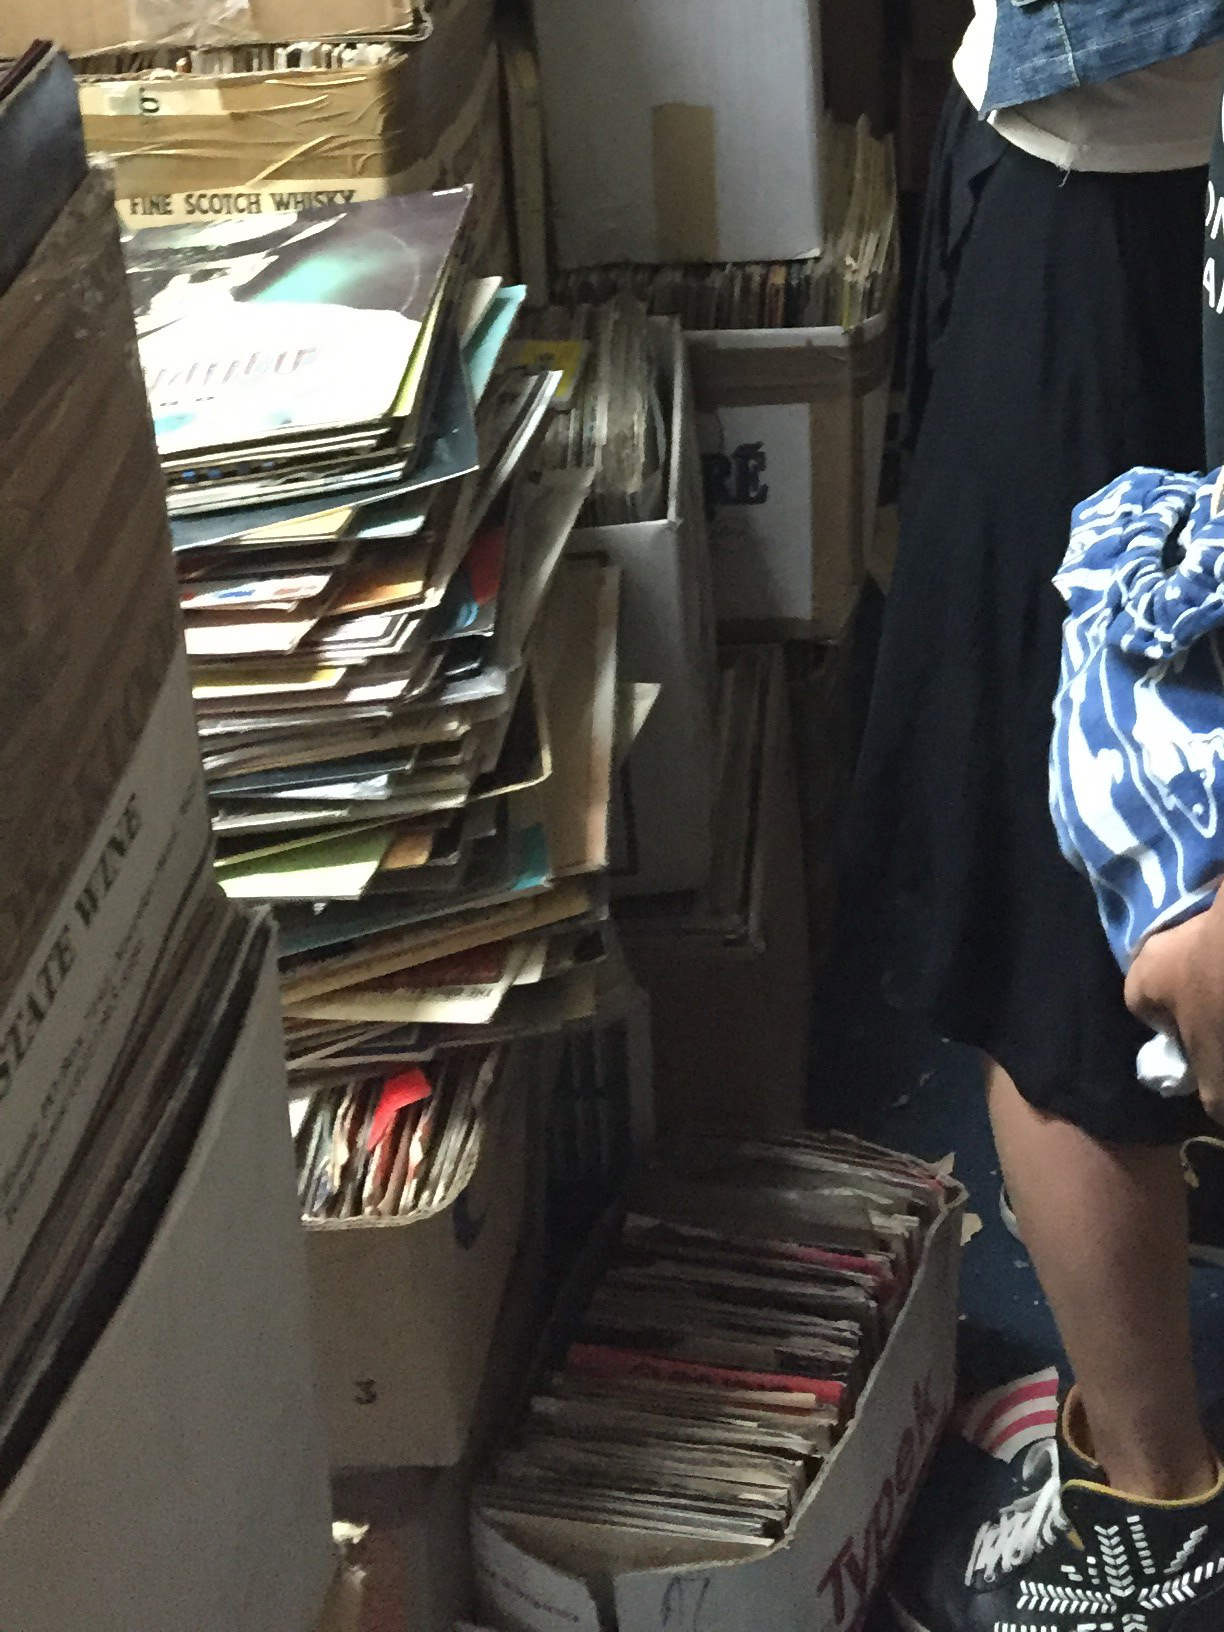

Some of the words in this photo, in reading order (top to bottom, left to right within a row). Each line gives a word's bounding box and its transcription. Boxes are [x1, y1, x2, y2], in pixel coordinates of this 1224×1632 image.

[129, 196, 174, 217] FINE
[184, 192, 264, 216] SCOTCH
[270, 189, 356, 214] WHISKY
